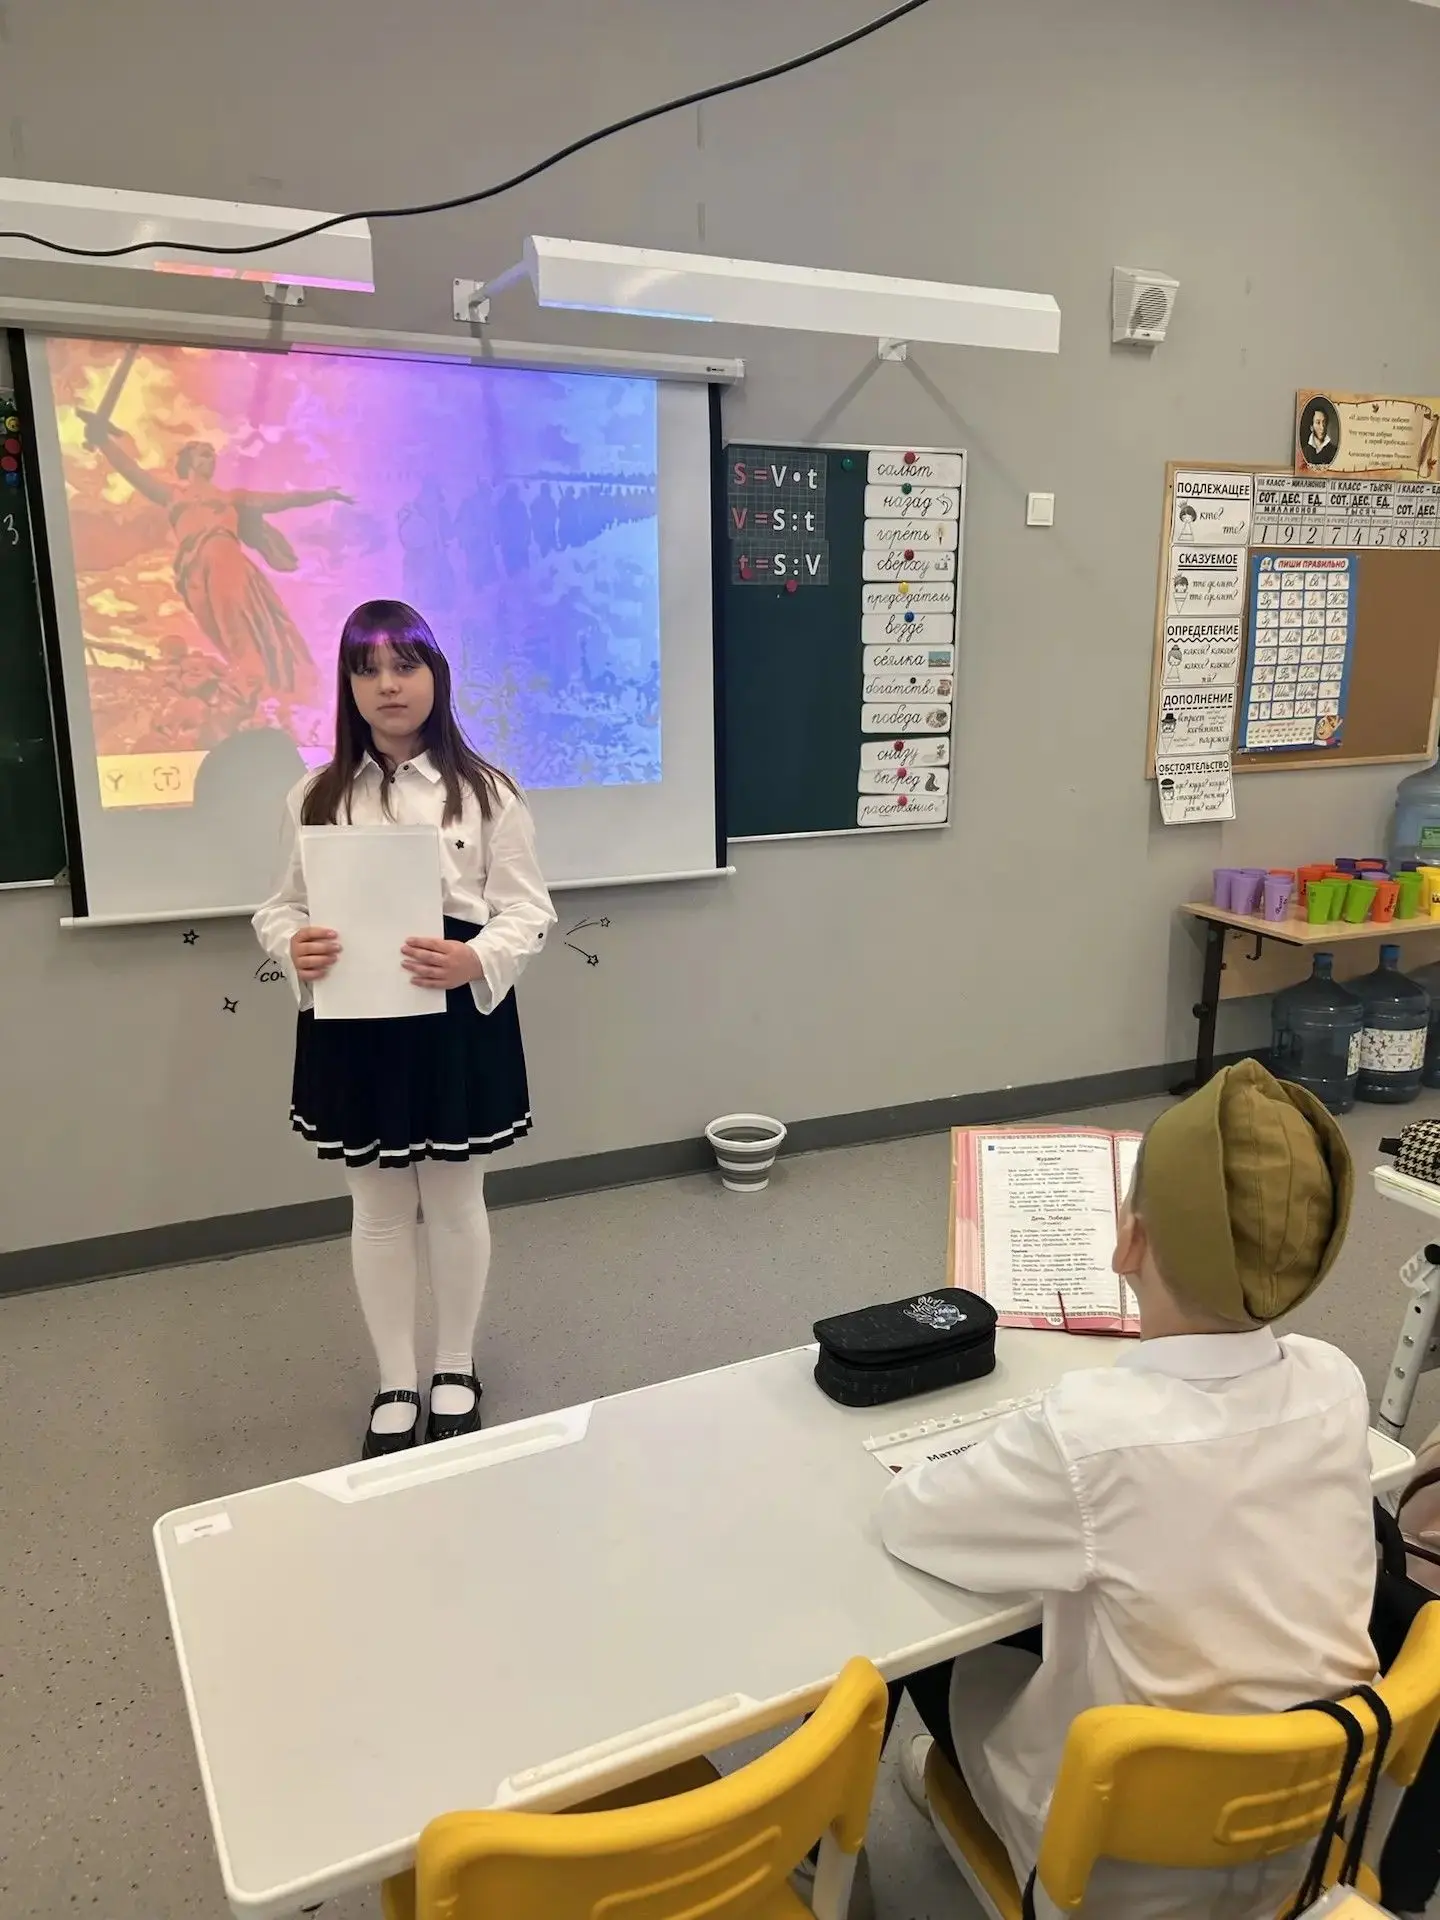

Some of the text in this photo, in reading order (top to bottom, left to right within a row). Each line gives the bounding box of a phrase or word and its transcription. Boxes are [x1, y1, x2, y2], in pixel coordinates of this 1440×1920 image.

[1177, 482, 1250, 497] ПОДЛЕЖАЩЕЕ
[1337, 482, 1361, 491] КЛАСС
[1369, 483, 1393, 493] ТЫСЯЧ
[1401, 485, 1425, 494] КЛАСС
[1259, 492, 1390, 509] СОТ. ДЕС. ЕД. СОТ. ДЕС. ЕД.
[1396, 504, 1436, 518] СОТ. ДЕС.
[1282, 525, 1294, 545] 9
[1306, 526, 1318, 544] 2
[1331, 527, 1342, 545] 7
[1352, 527, 1362, 545] 4
[1374, 527, 1386, 546] 5
[1396, 528, 1408, 546] 8
[1418, 529, 1429, 546] 3
[1178, 553, 1238, 564] СКАЗУЕМОЕ
[1278, 560, 1346, 568] ПИШИ ПРАВИЛЬНО
[1167, 625, 1239, 638] ОПРЕДЕЛЕНИЕ
[1163, 693, 1233, 707] ДОПОЛНЕНИЕ
[1158, 760, 1229, 773] ОБСТОЯТЕЛЬСТВО
